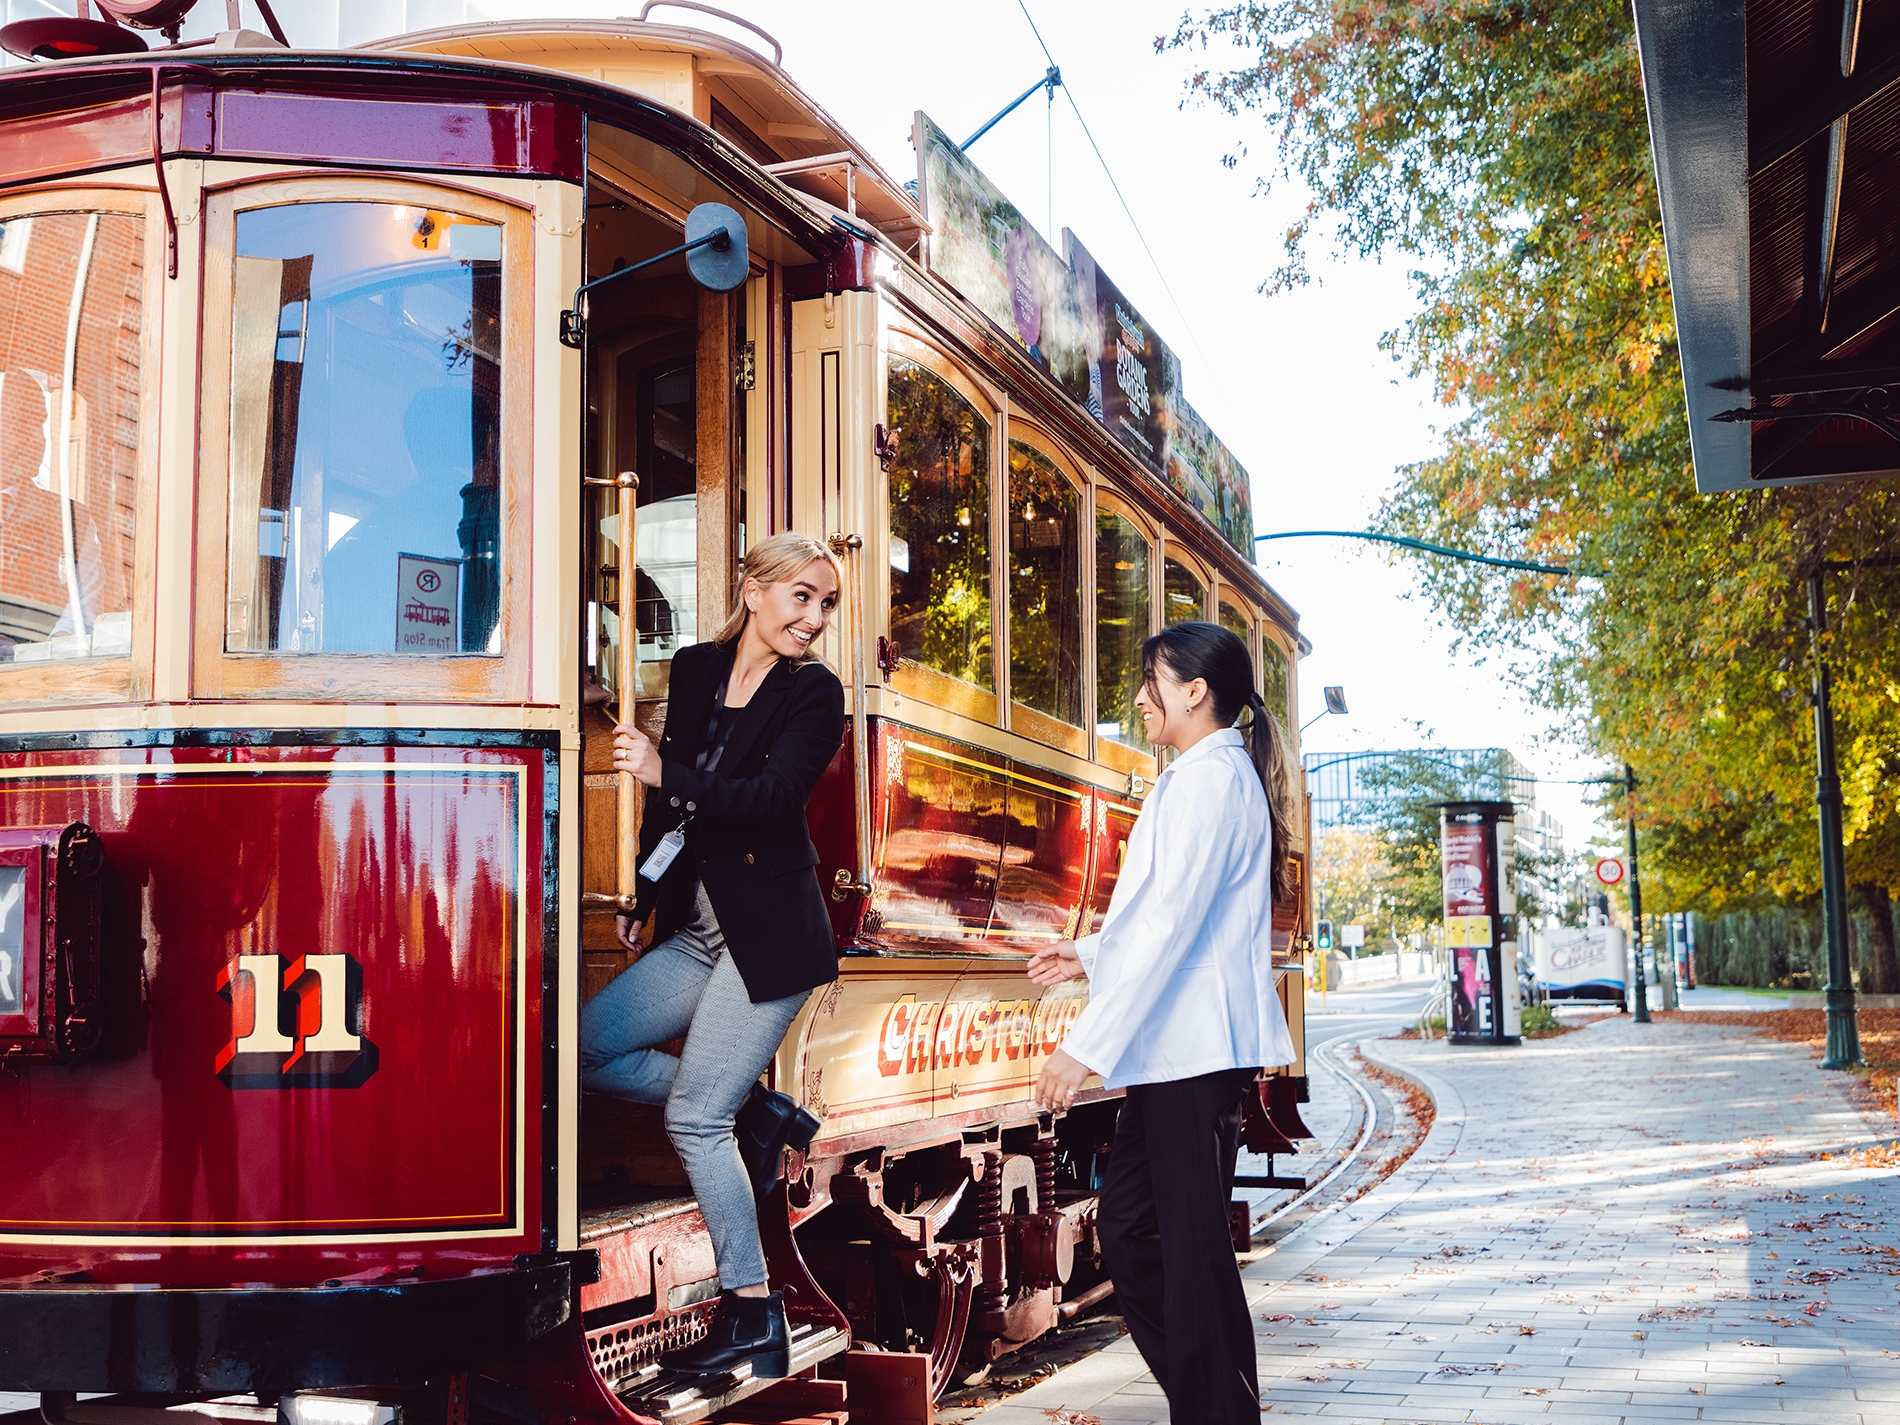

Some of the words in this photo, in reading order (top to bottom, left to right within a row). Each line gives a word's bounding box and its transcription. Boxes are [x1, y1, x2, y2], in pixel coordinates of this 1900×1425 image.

[422, 237, 428, 249] 1
[1016, 290, 1035, 316] Gardens
[1116, 338, 1148, 391] BOTANIC
[1116, 362, 1151, 416] GARDENS
[1602, 864, 1618, 877] 30
[232, 953, 364, 1057] 11
